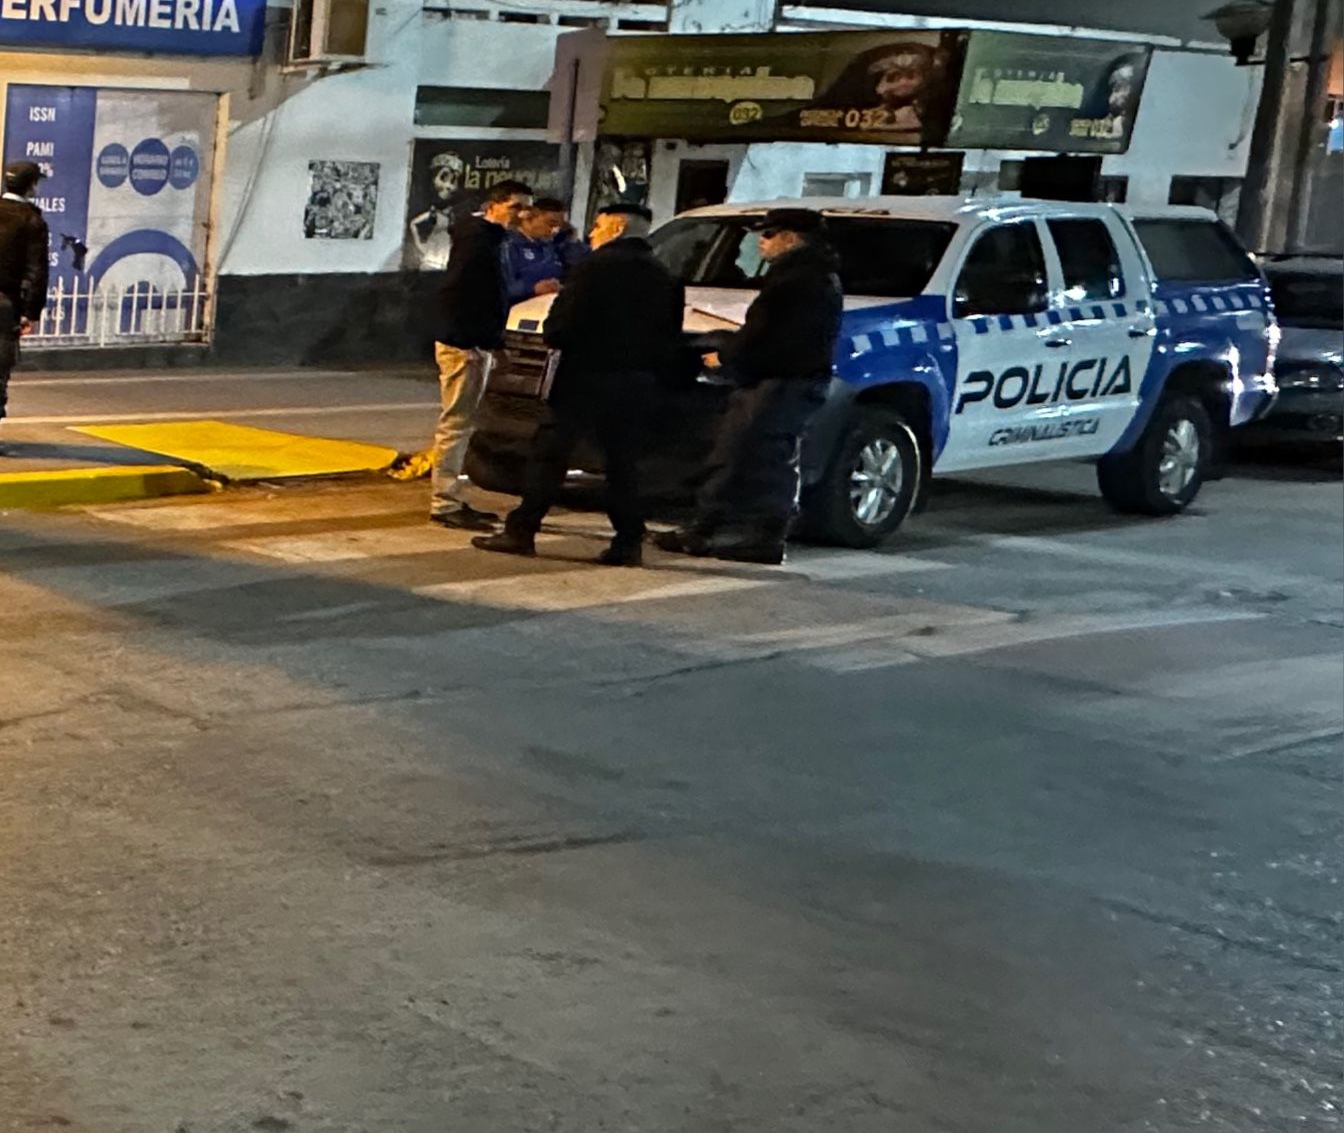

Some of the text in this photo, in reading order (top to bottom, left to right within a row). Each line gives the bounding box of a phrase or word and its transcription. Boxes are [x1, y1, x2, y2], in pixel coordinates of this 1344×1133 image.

[29, 106, 56, 122] ISSN
[26, 141, 54, 157] PAMI
[464, 164, 480, 189] la
[955, 355, 1131, 414] POLICIA
